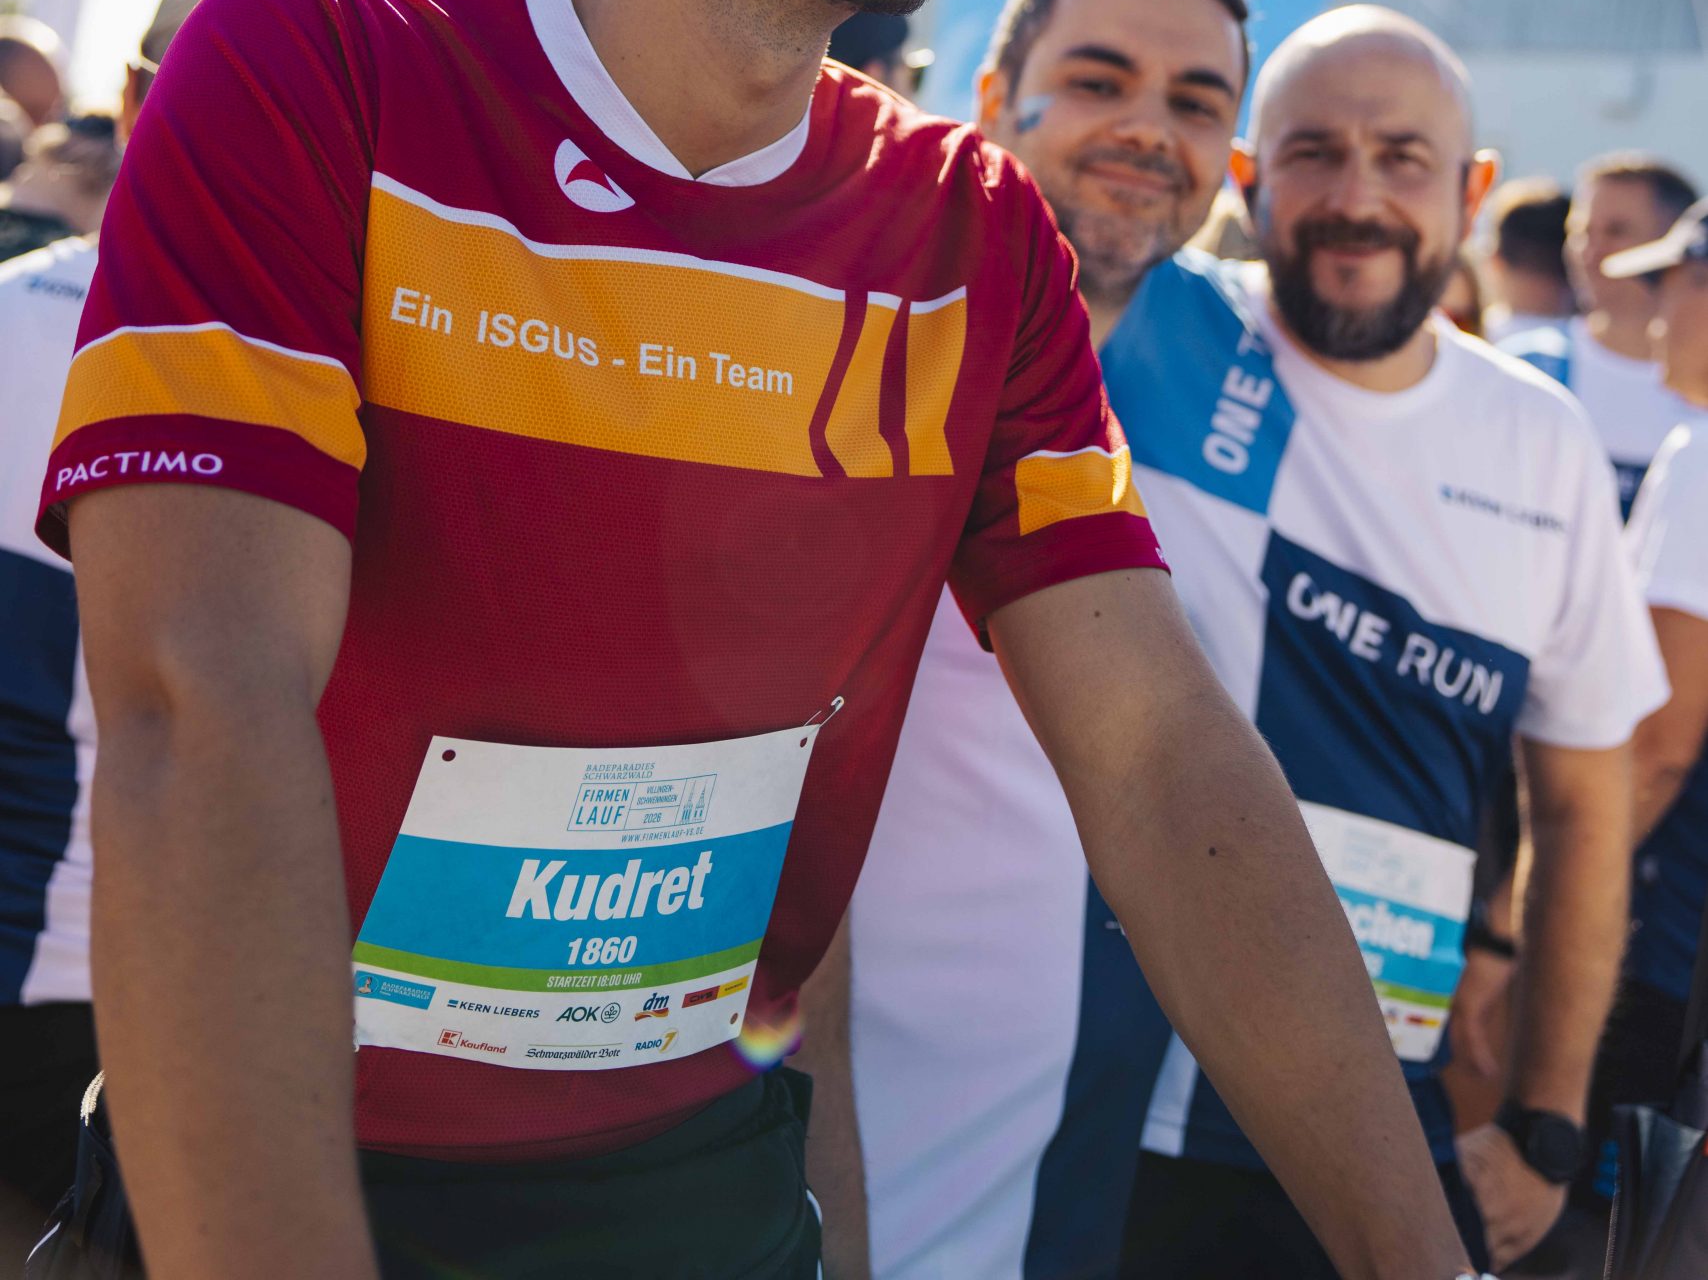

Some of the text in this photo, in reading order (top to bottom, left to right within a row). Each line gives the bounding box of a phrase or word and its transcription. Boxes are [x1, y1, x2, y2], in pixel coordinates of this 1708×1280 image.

[389, 286, 453, 335] Ein
[477, 310, 600, 367] ISGUS
[638, 343, 698, 381] Ein
[708, 352, 794, 396] Team
[1202, 364, 1275, 475] ONE
[55, 450, 224, 492] PACTIMO
[1286, 572, 1504, 716] ONE RUN
[585, 762, 656, 772] BADEPARADIES
[582, 771, 654, 781] SCHWARZWALD
[582, 788, 631, 802] FIRMEN
[636, 794, 678, 806] SCHWENNINGEN
[575, 805, 626, 825] LAUF
[621, 826, 705, 843] WWW.FIRMENLAUF-VS.DE
[505, 850, 713, 921] Kudret
[567, 935, 638, 965] 1860
[546, 972, 642, 988] STARTZEIT 18:00 UHR
[459, 1001, 541, 1019] KERN LIEBERS
[643, 992, 670, 1012] dm
[556, 1006, 601, 1022] AOK
[459, 1038, 507, 1054] Kaufland
[635, 1038, 662, 1051] RADIO
[525, 1048, 621, 1060] Schwarzwälder Bote
